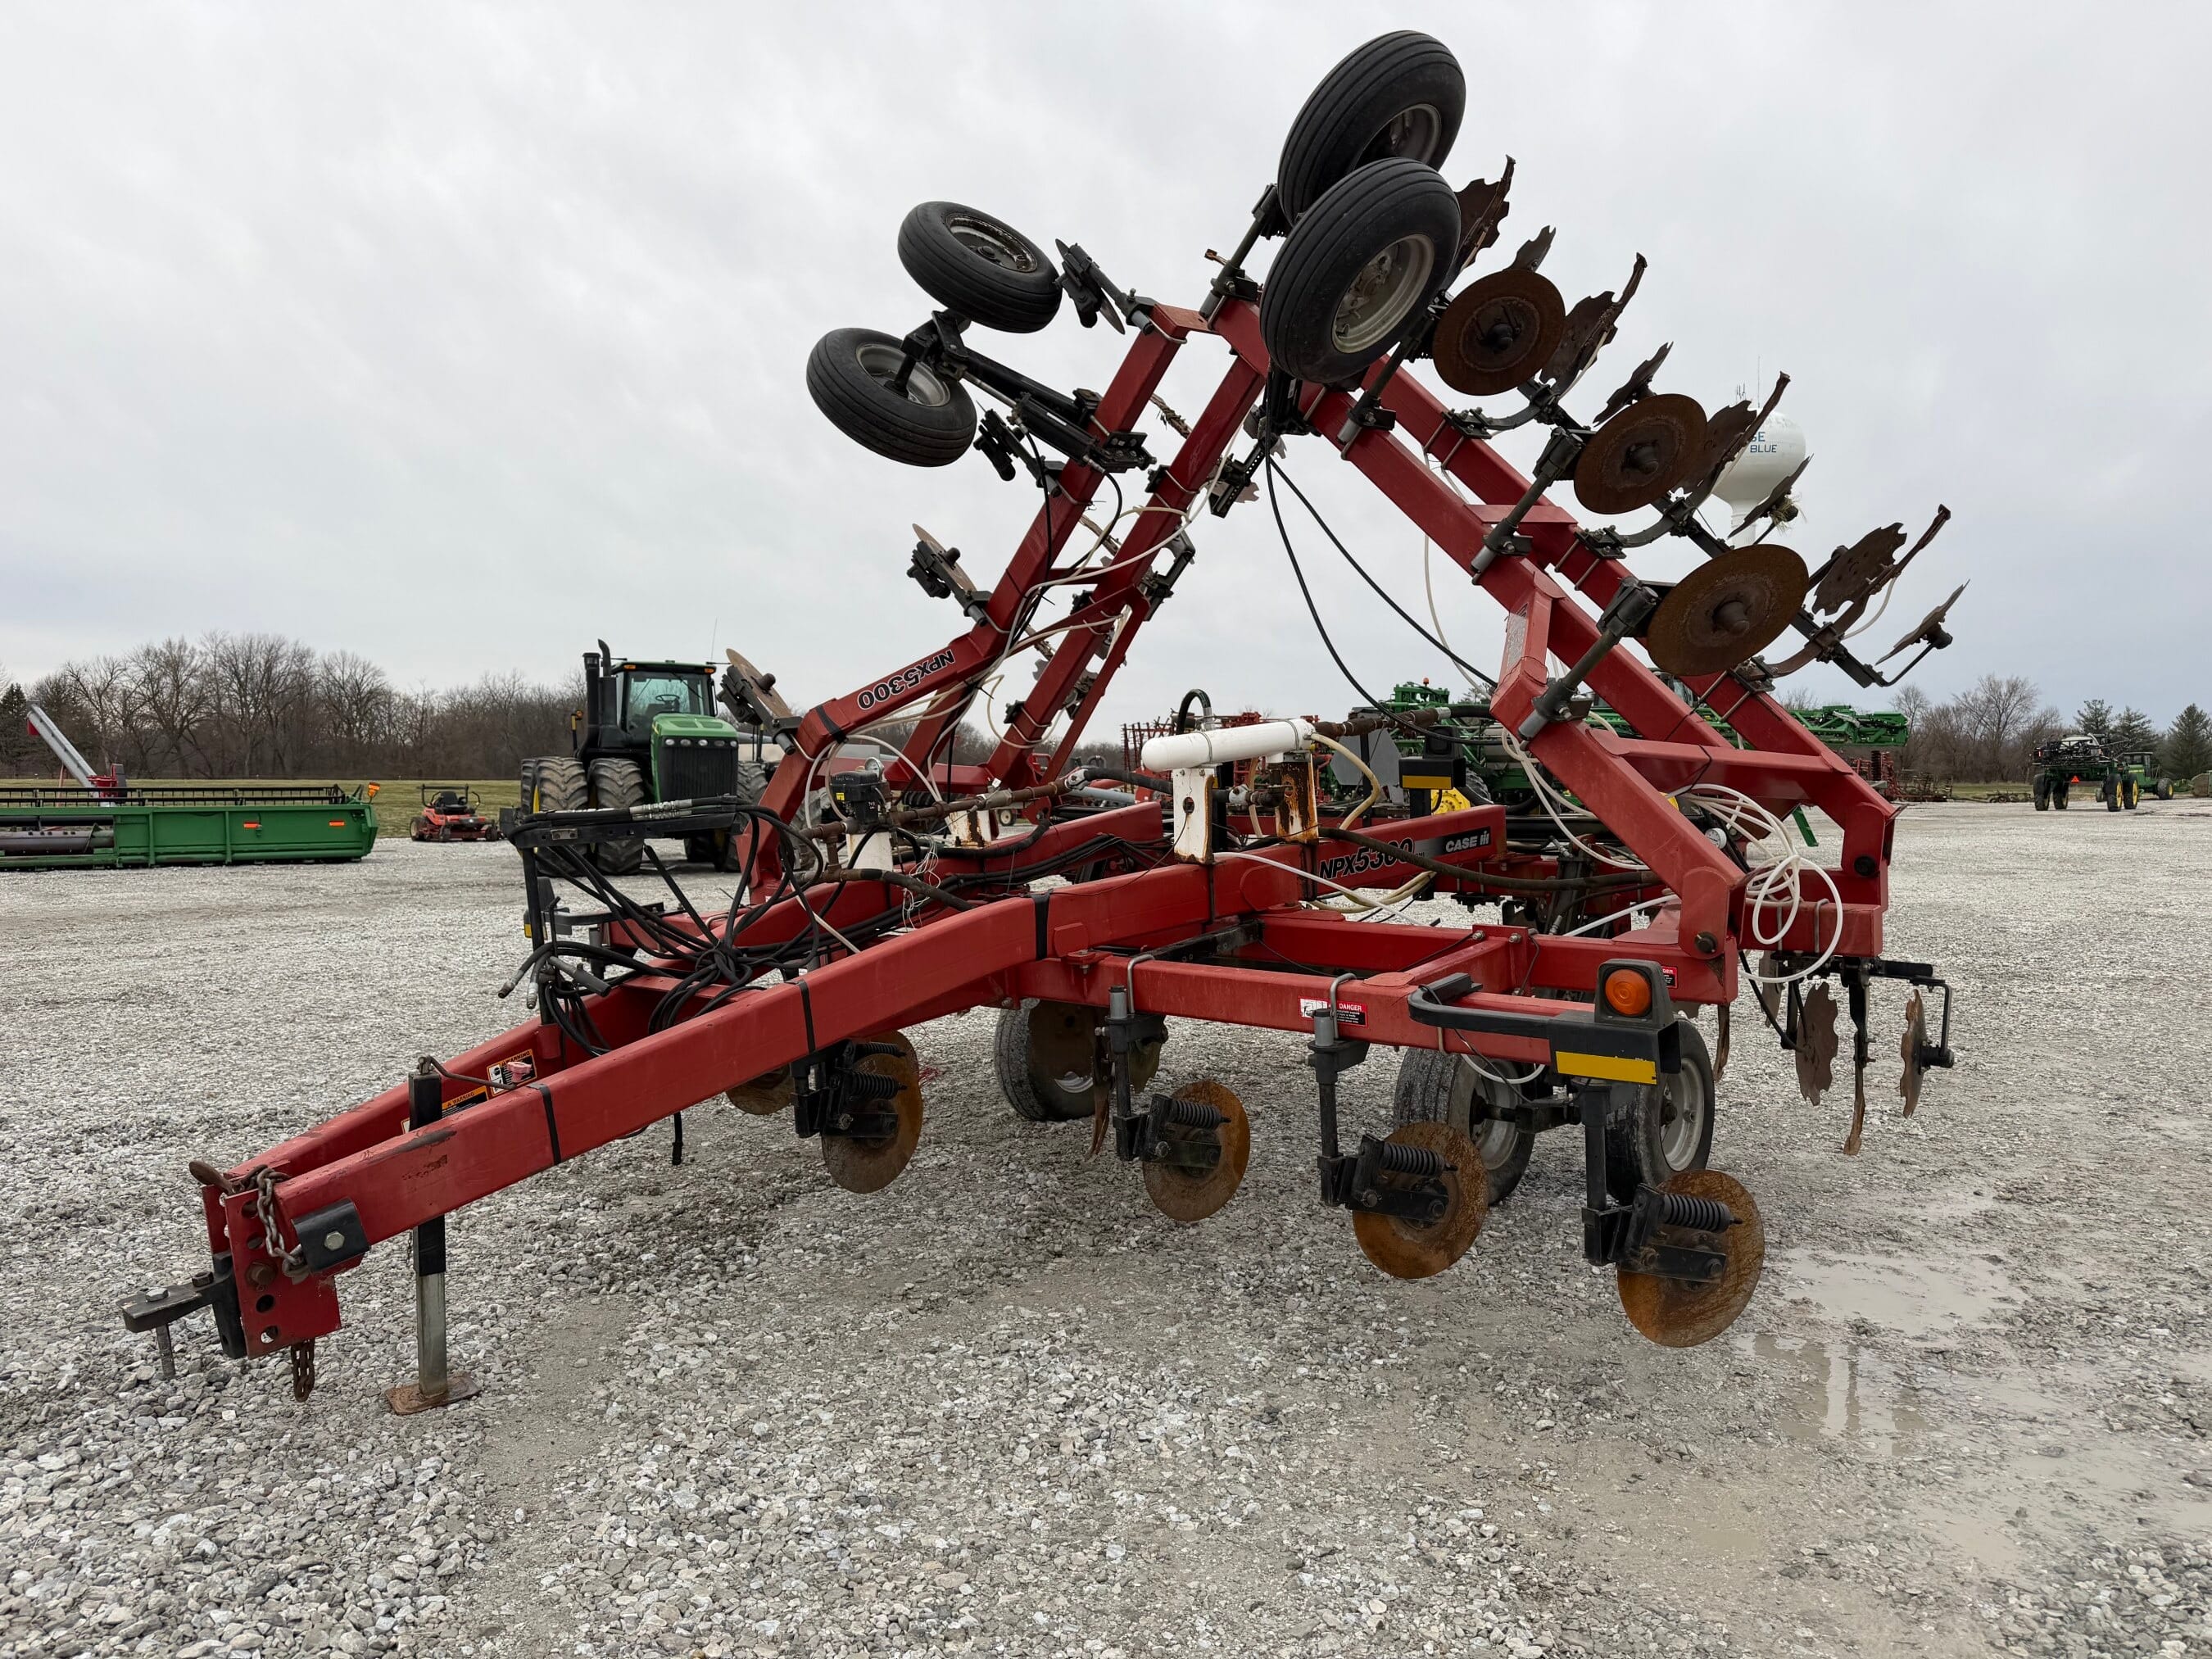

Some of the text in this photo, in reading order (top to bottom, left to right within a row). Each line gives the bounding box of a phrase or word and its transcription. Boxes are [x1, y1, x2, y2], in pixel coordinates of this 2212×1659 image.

[1750, 444, 1777, 453] BLUE
[857, 649, 956, 710] NPX5300
[1445, 835, 1478, 853] CASE
[1339, 1003, 1362, 1012] DANGER
[452, 1091, 475, 1104] WARNING
